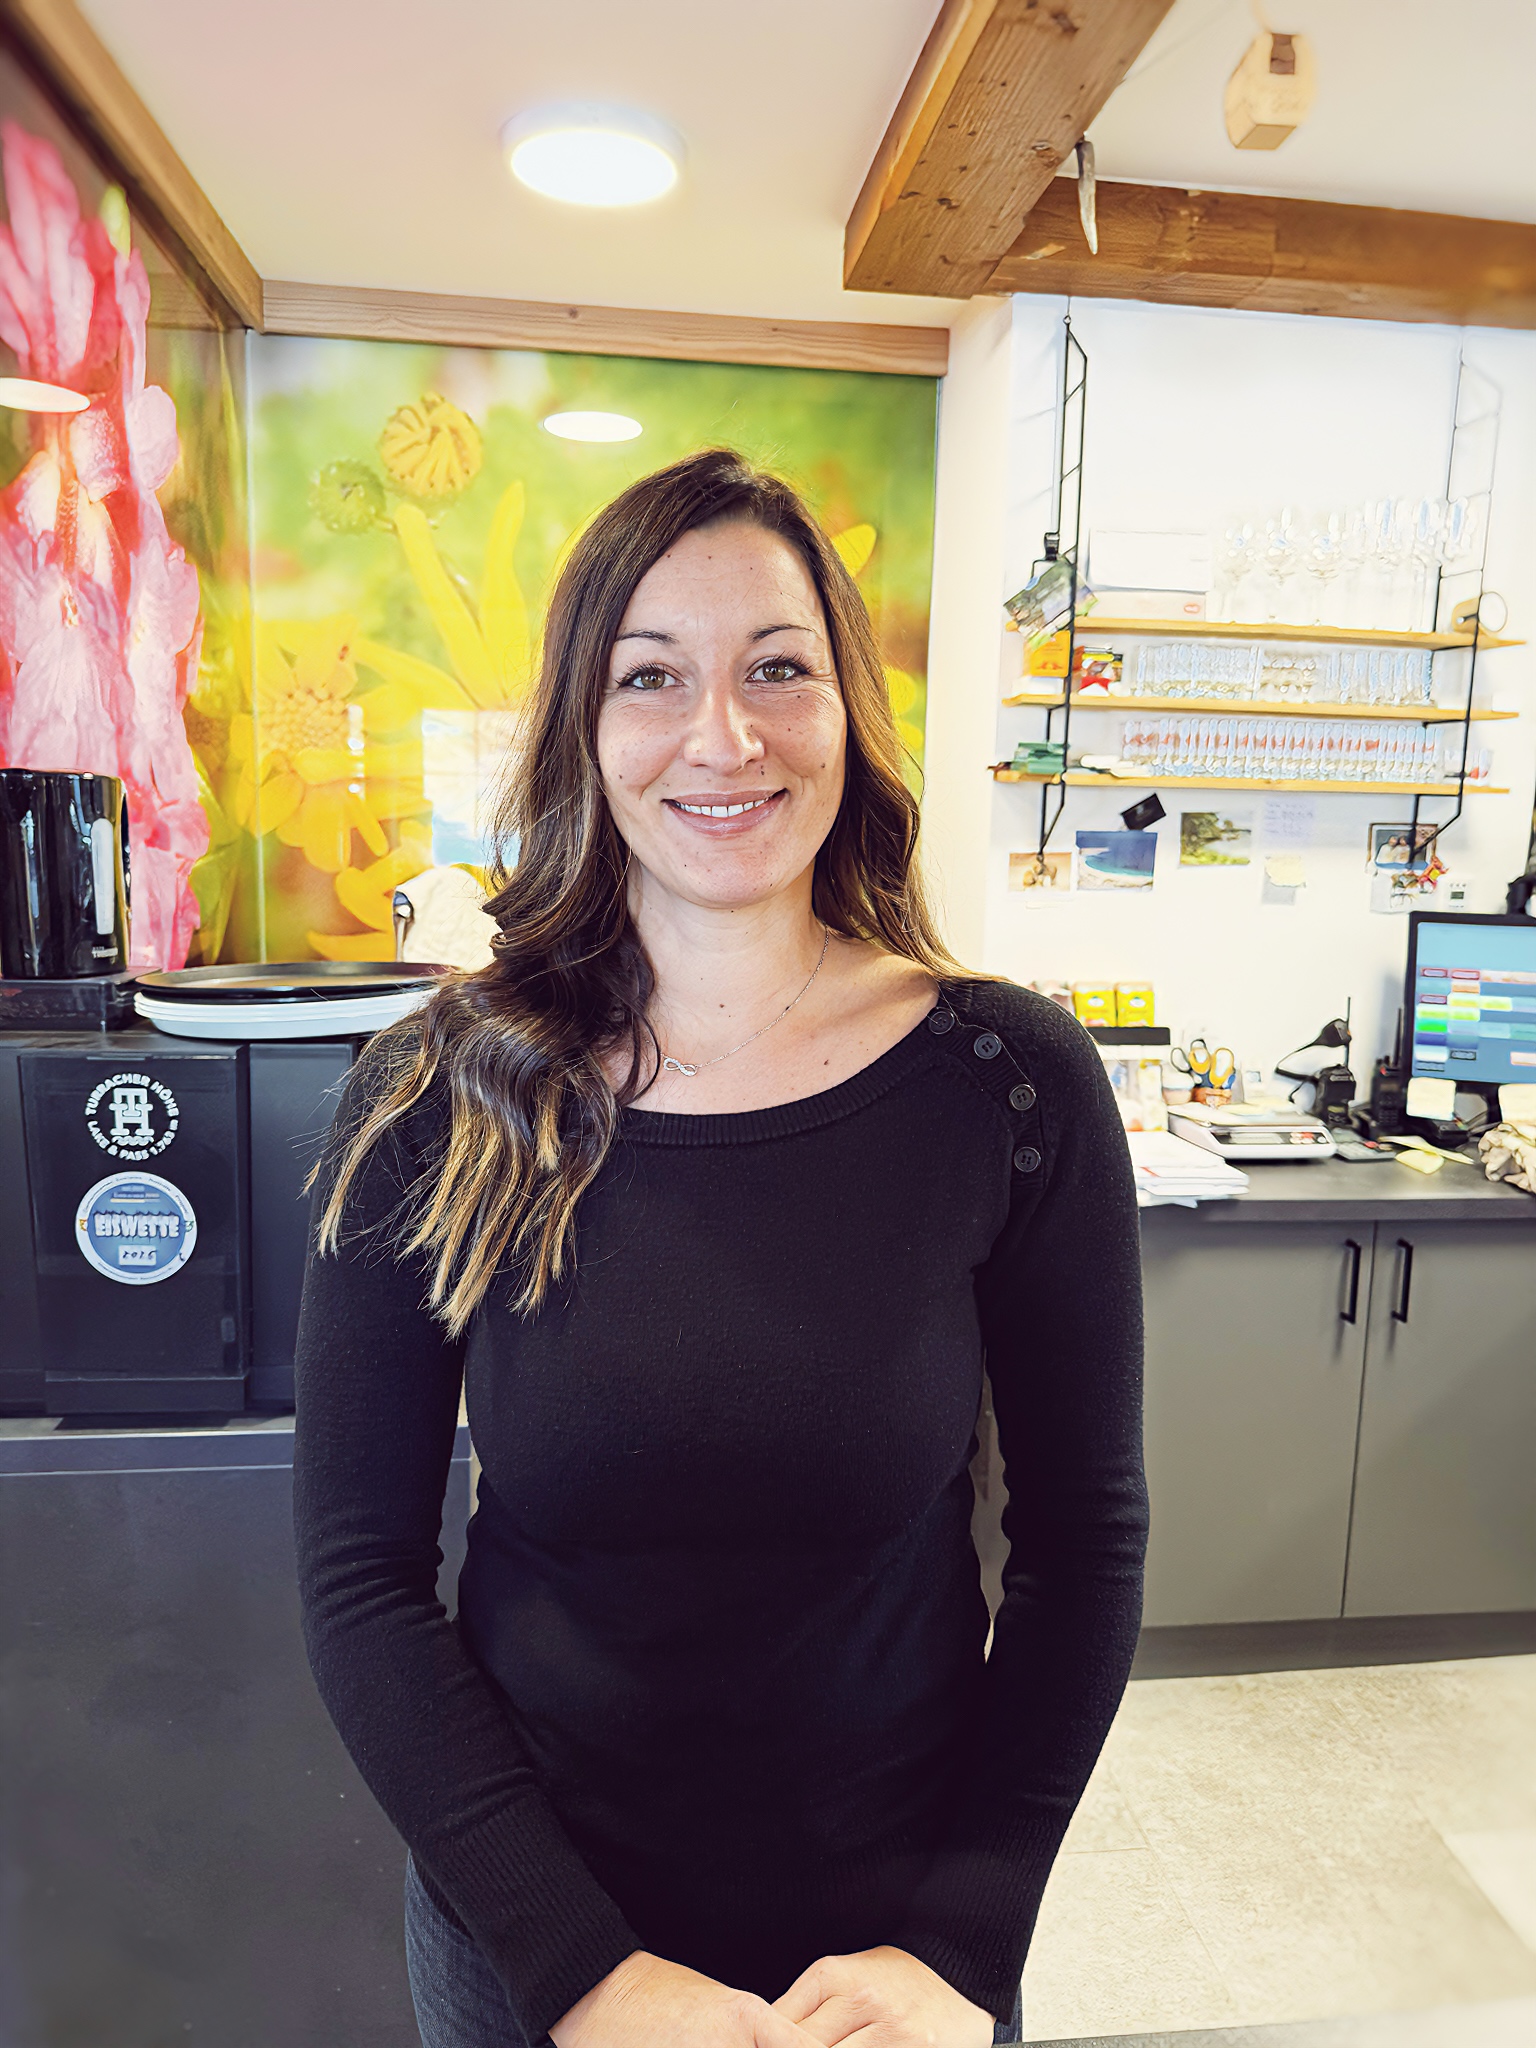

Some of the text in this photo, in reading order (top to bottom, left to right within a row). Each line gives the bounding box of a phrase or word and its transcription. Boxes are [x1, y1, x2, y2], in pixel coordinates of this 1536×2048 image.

[87, 1120, 110, 1149] LAKE
[119, 1149, 150, 1161] PASS
[94, 1213, 180, 1238] EISWETTE
